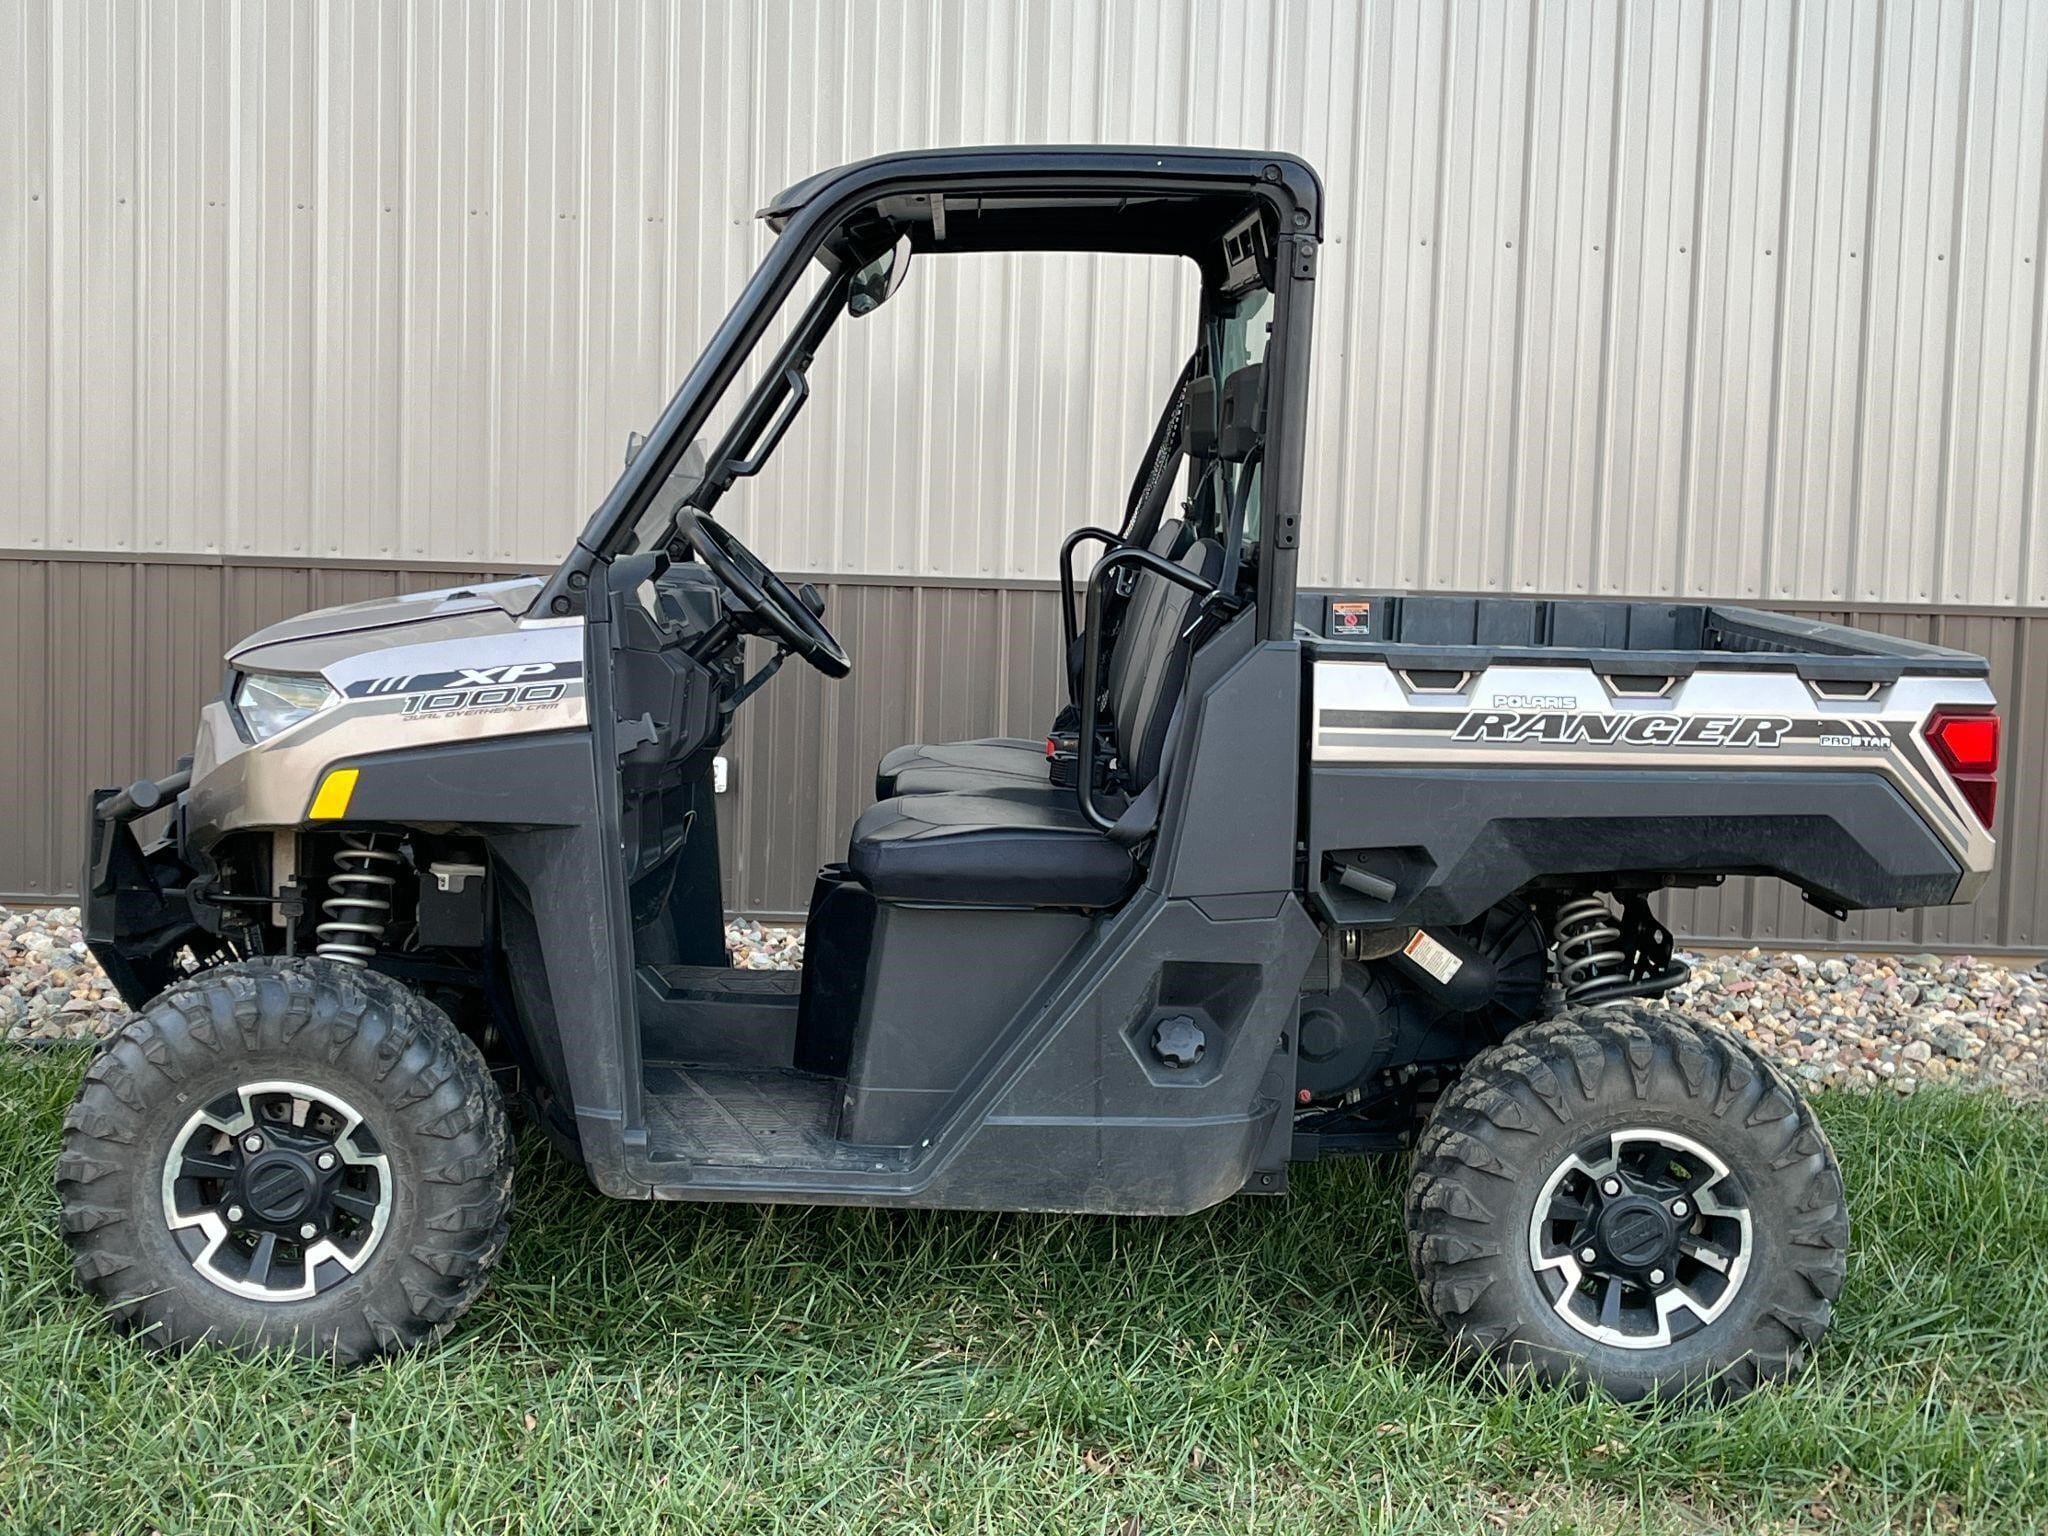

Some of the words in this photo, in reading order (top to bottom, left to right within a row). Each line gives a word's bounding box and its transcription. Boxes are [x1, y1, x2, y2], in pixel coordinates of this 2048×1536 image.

[444, 662, 557, 687] XP
[402, 682, 567, 715] 1000
[1493, 694, 1577, 709] POLARIS
[403, 713, 441, 721] DUAL
[445, 704, 523, 718] OVERHEAD
[526, 703, 559, 711] CAM
[1451, 709, 1793, 748] RANGER
